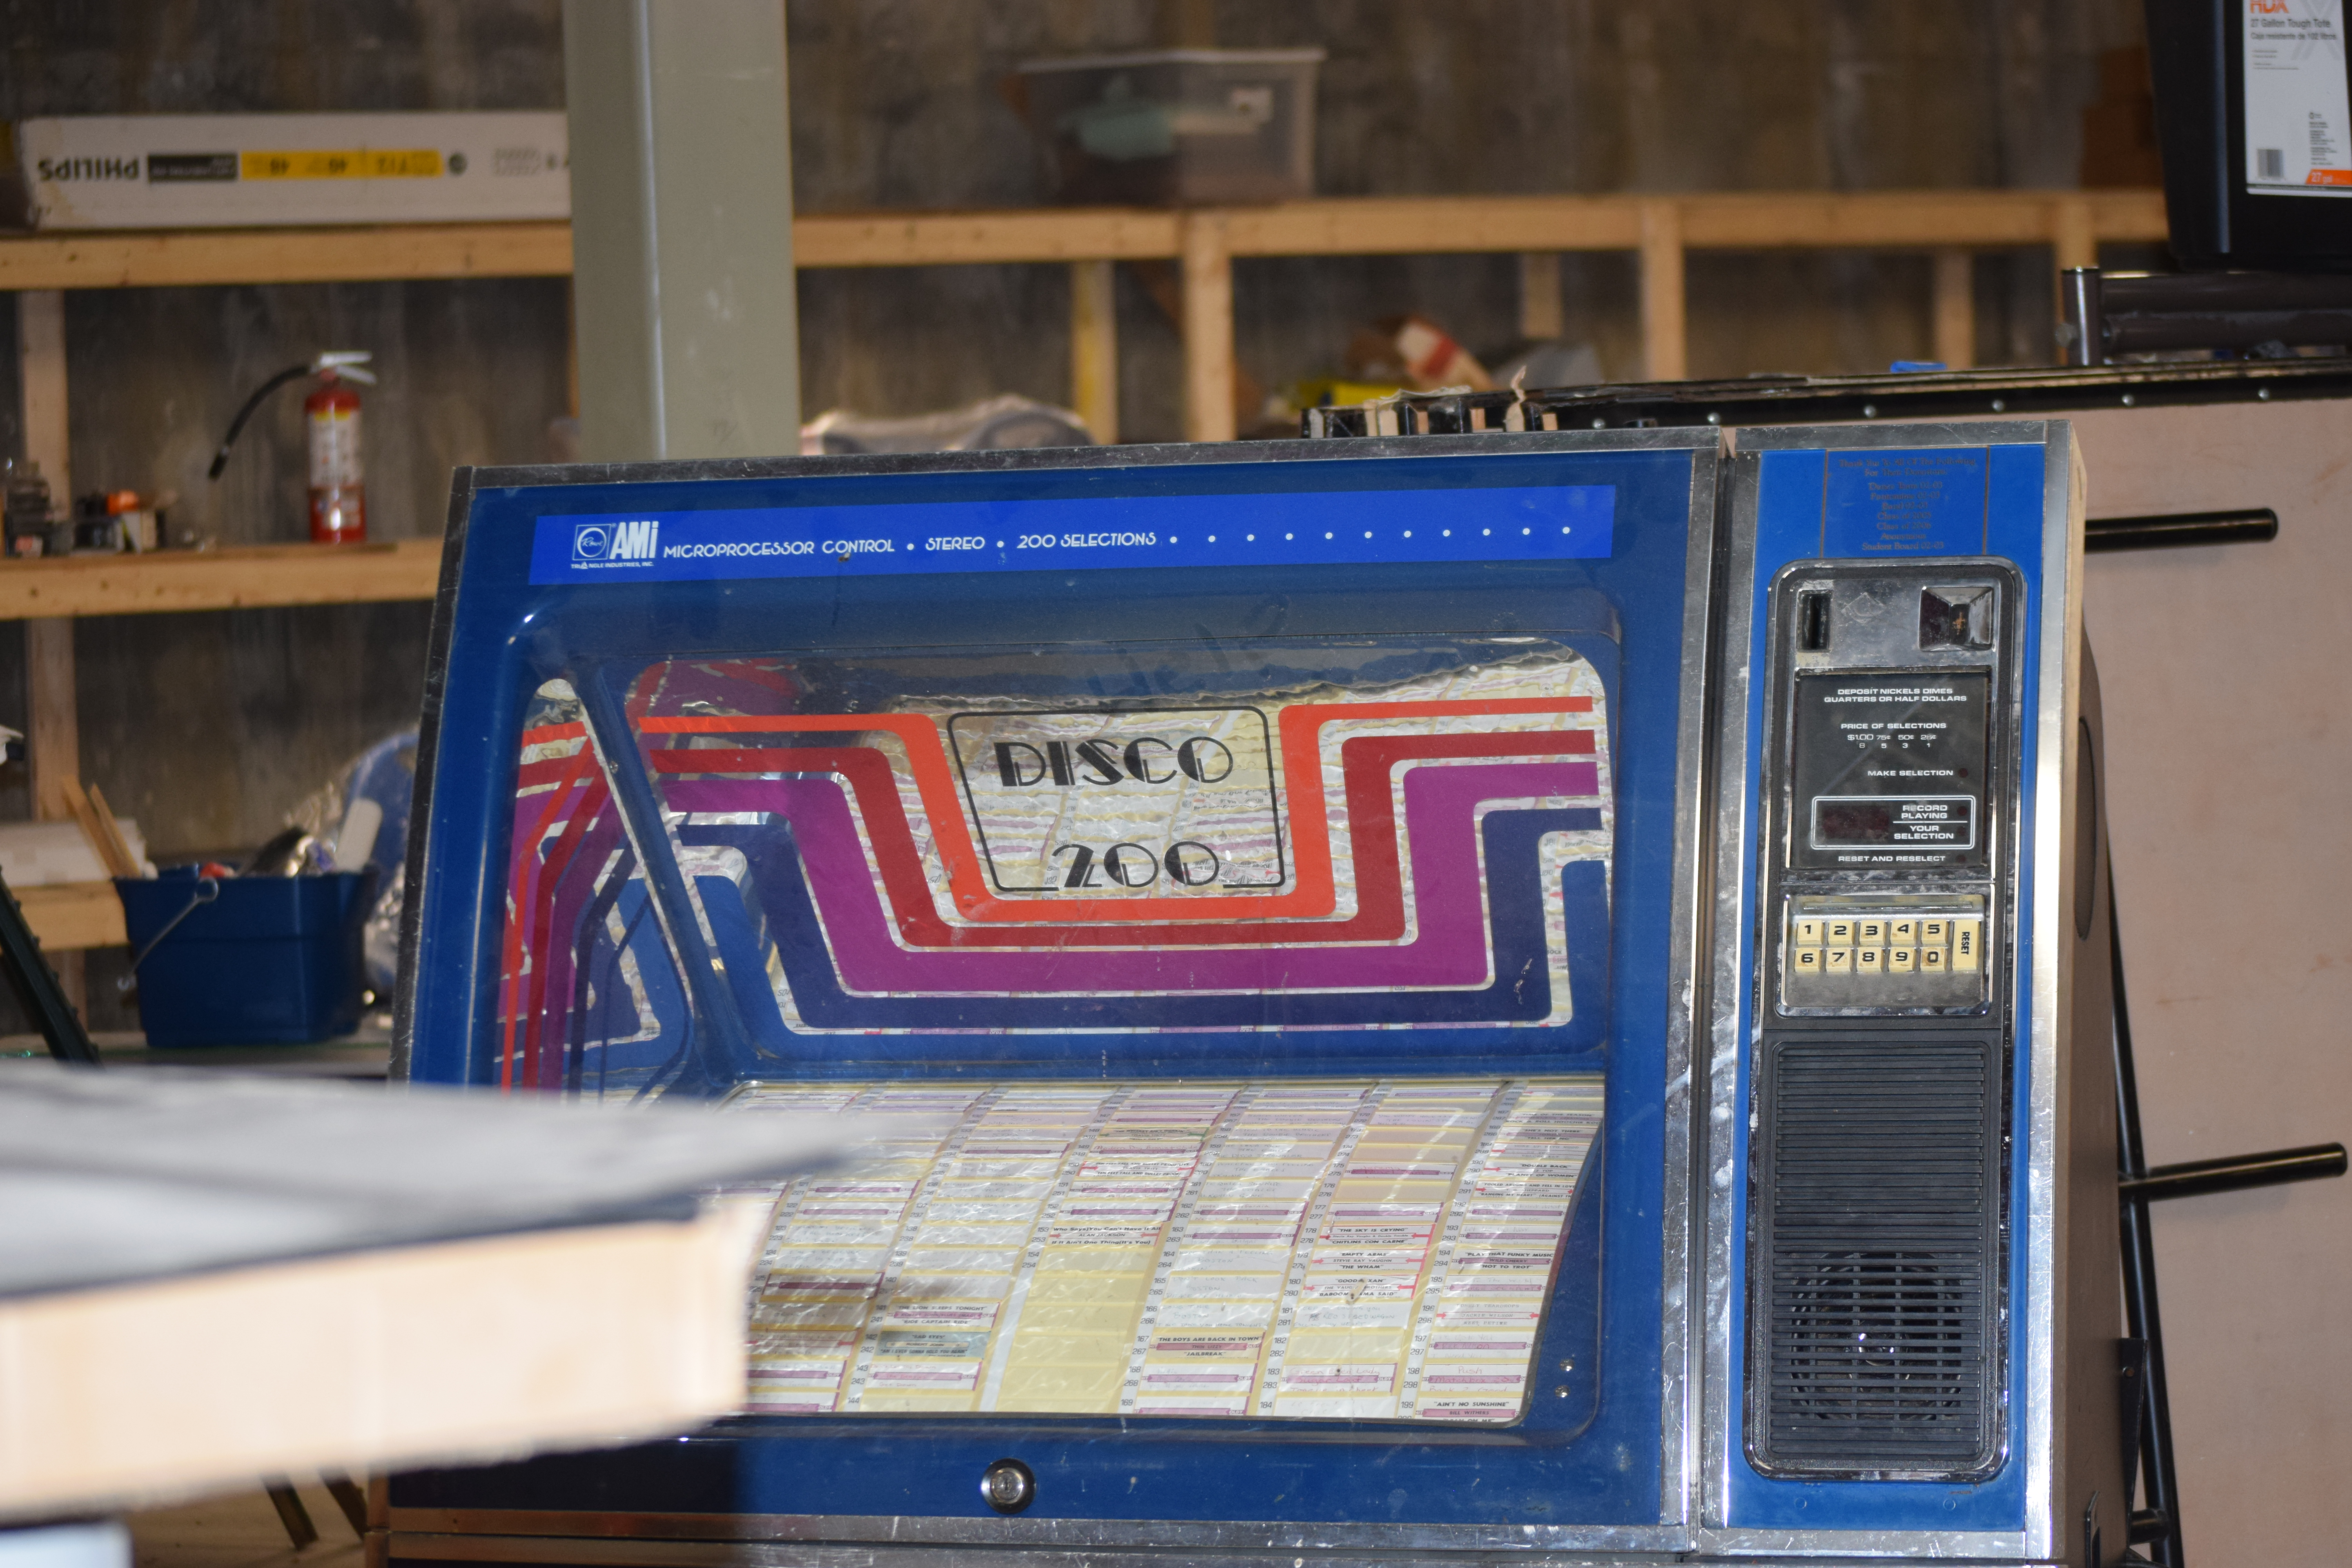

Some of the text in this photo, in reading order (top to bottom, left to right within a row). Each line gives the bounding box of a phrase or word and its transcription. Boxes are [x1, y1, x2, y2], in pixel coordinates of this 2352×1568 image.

[2261, 19, 2285, 27] Gallon
[2288, 18, 2311, 29] Tough
[2314, 18, 2330, 27] Tote
[38, 158, 139, 181] PHILIPS
[2312, 172, 2322, 182] 27
[1839, 459, 1862, 467] Thank
[1936, 457, 1975, 466] Following
[926, 536, 985, 551] STEREO
[1016, 532, 1156, 549] 200 SELECTIONS
[1862, 542, 1892, 550] Student
[663, 539, 895, 558] MICROPROCESSOR CONTROL
[993, 736, 1234, 787] DISCO
[1051, 841, 1220, 889] 200
[1804, 924, 1940, 936] 1 2 3 4 5
[1960, 931, 1970, 955] RESET
[1801, 951, 1939, 964] 6 7 8 9 0
[1458, 1366, 1483, 1375] Push
